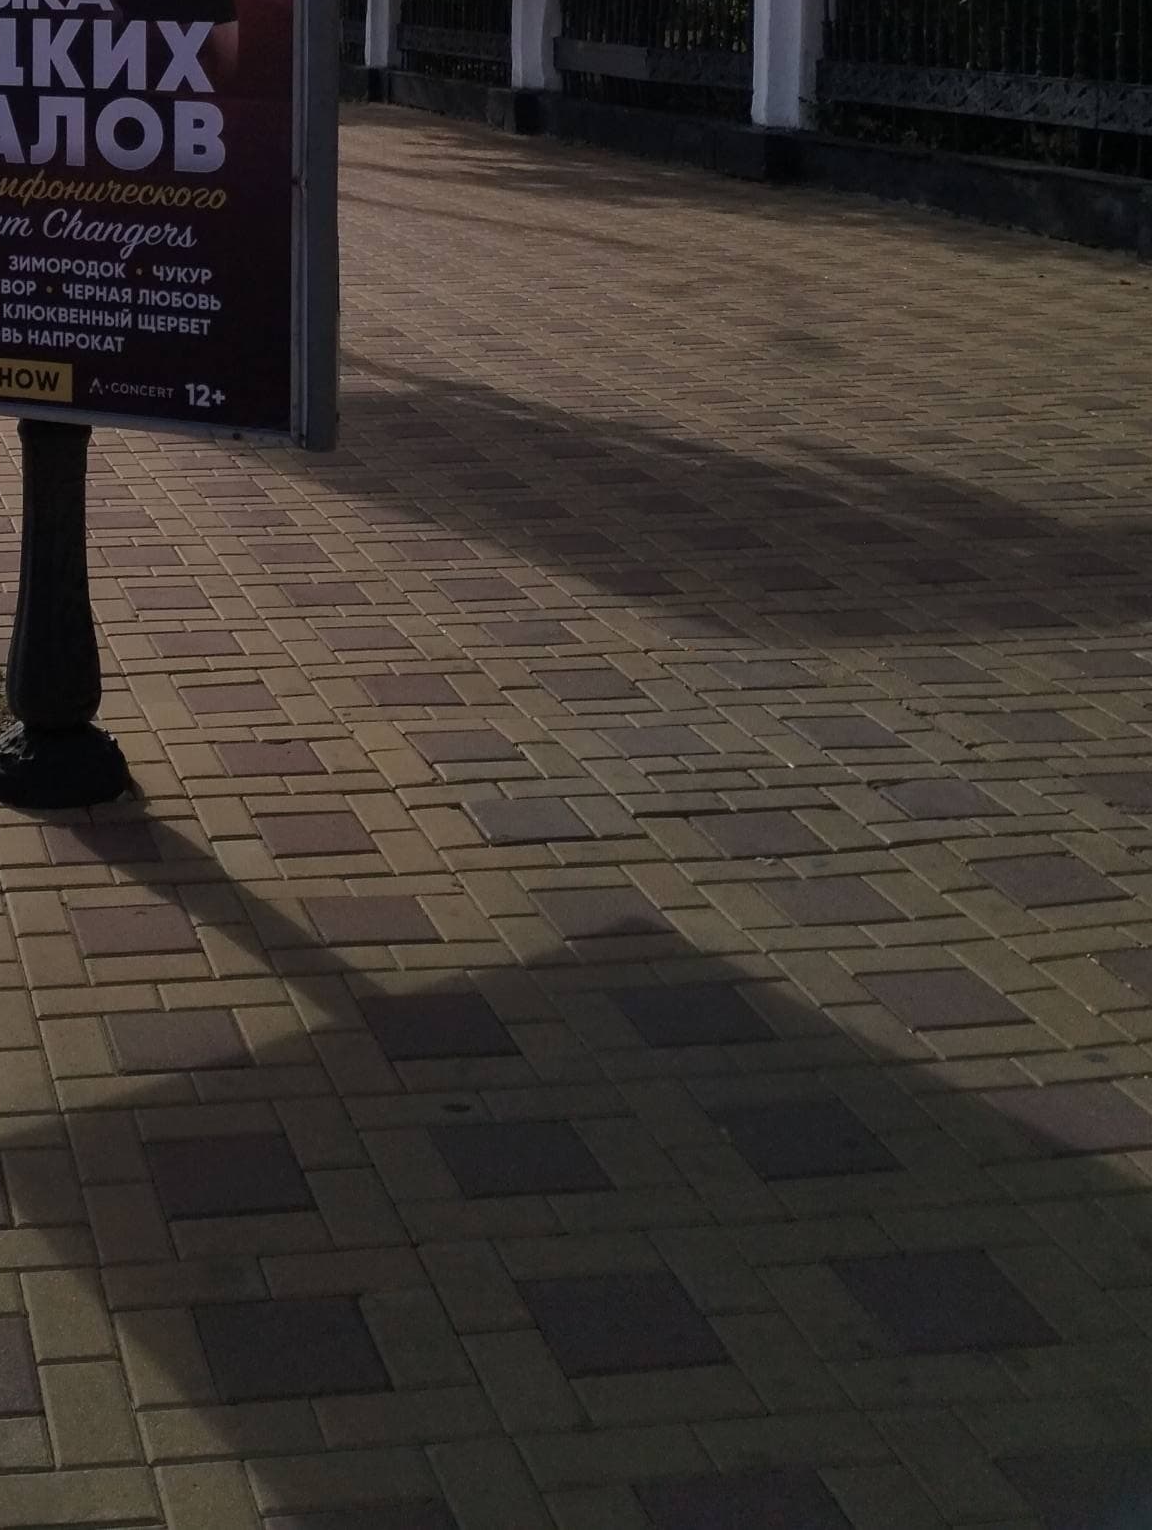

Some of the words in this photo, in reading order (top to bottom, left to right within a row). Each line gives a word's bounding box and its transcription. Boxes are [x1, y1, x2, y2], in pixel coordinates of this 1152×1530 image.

[43, 209, 196, 258] Changers
[9, 255, 126, 278] ЗИМОРОДОК
[153, 264, 212, 285] ЧУКУР
[62, 283, 133, 304] ЧЕРНАЯ
[138, 287, 221, 311] ЛЮБОВЬ
[3, 303, 134, 329] КЛЮКВЕННЫЙ
[138, 313, 211, 335] ЩЕРБЕТ
[28, 328, 125, 353] НАПРОКАТ
[185, 383, 225, 407] 12+
